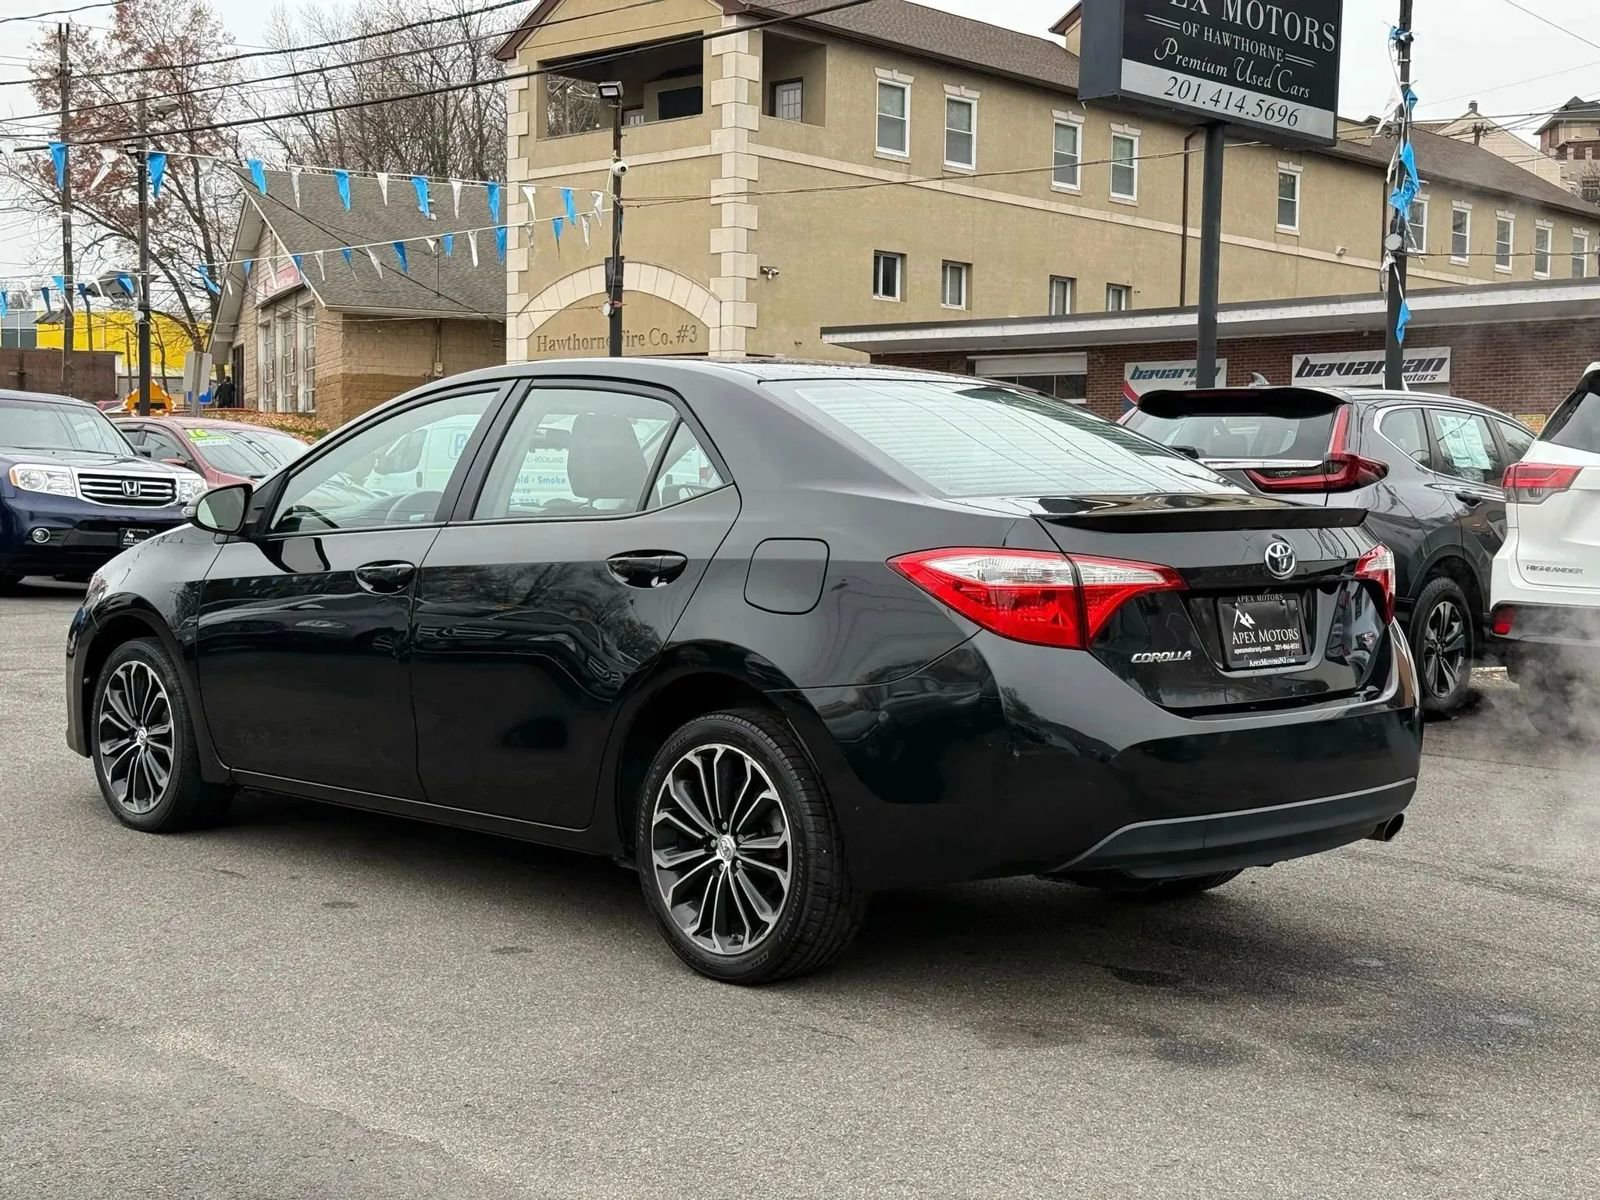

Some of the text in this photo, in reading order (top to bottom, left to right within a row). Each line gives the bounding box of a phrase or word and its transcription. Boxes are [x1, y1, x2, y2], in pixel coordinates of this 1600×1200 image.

[1221, 0, 1336, 52] MOTORS
[1182, 20, 1284, 62] OF HAWTHORNE
[1154, 37, 1310, 99] Premium Used Cars
[1164, 76, 1300, 127] 201.414.5696
[621, 329, 646, 348] ire
[648, 327, 673, 346] Co.
[676, 324, 698, 344] #3
[1129, 364, 1222, 380] bavari
[1294, 356, 1449, 378] bavaran
[1402, 373, 1438, 382] otors
[537, 475, 566, 484] Smoke
[1525, 564, 1584, 575] HIGHLANDER
[1237, 593, 1284, 602] APEX MOTORS
[1232, 628, 1299, 645] APEX MOTORS
[1131, 650, 1192, 663] COROLLA
